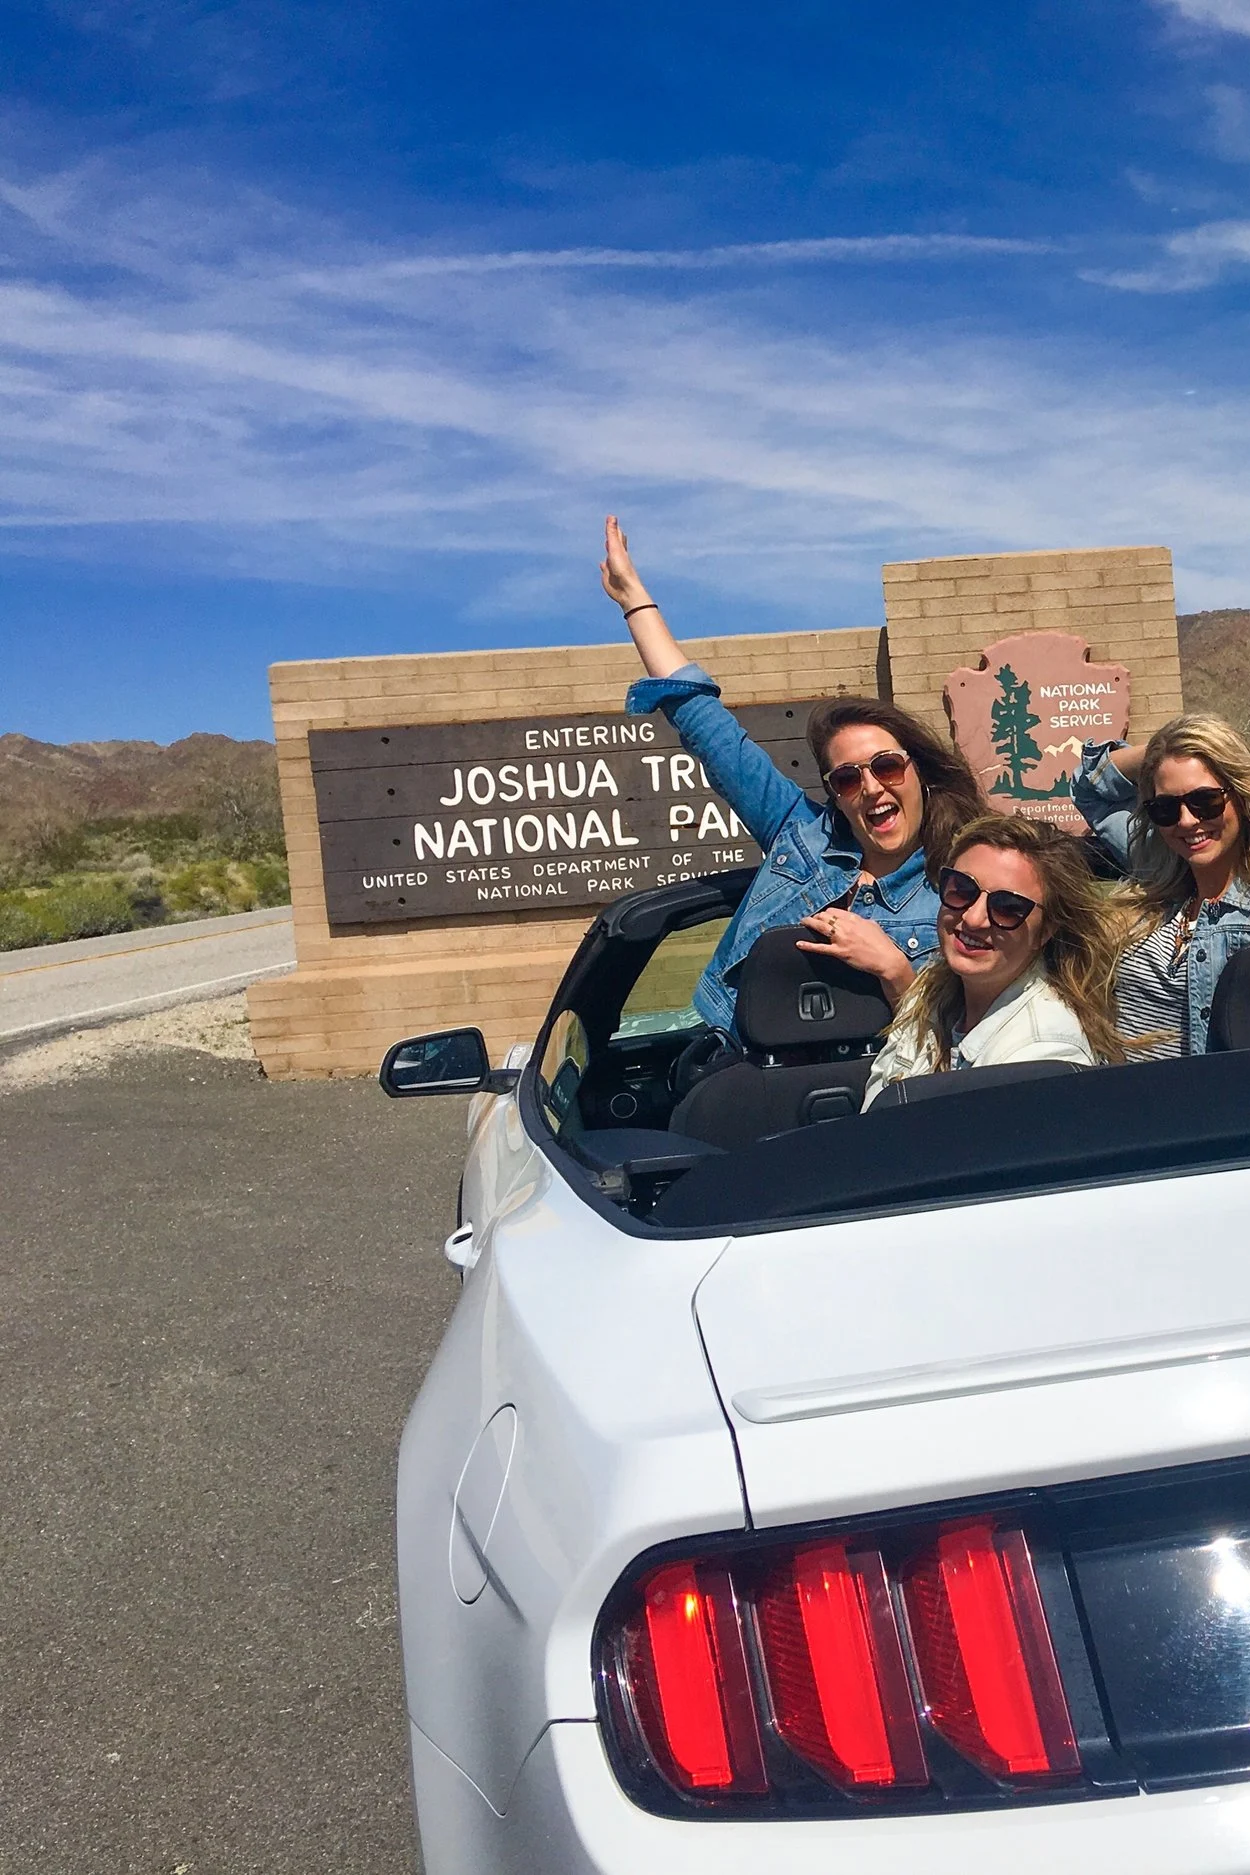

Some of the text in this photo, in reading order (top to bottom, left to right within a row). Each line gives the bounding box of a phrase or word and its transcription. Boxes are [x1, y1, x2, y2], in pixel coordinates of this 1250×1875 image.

[1040, 682, 1116, 698] NATIONAL
[1059, 698, 1100, 712] PARK
[1050, 713, 1113, 728] SERVICE
[525, 722, 655, 750] ENTERING
[439, 753, 711, 807] JOSHUA TR
[1012, 803, 1074, 815] Departmen
[414, 801, 752, 863] NATIONAL PAR
[362, 872, 428, 889] UNITED
[446, 866, 511, 883] STATES
[533, 856, 651, 881] DEPARTMENT
[672, 853, 693, 866] OF
[712, 849, 745, 863] THE
[477, 882, 568, 900] NATIONAL
[587, 877, 635, 892] PARK
